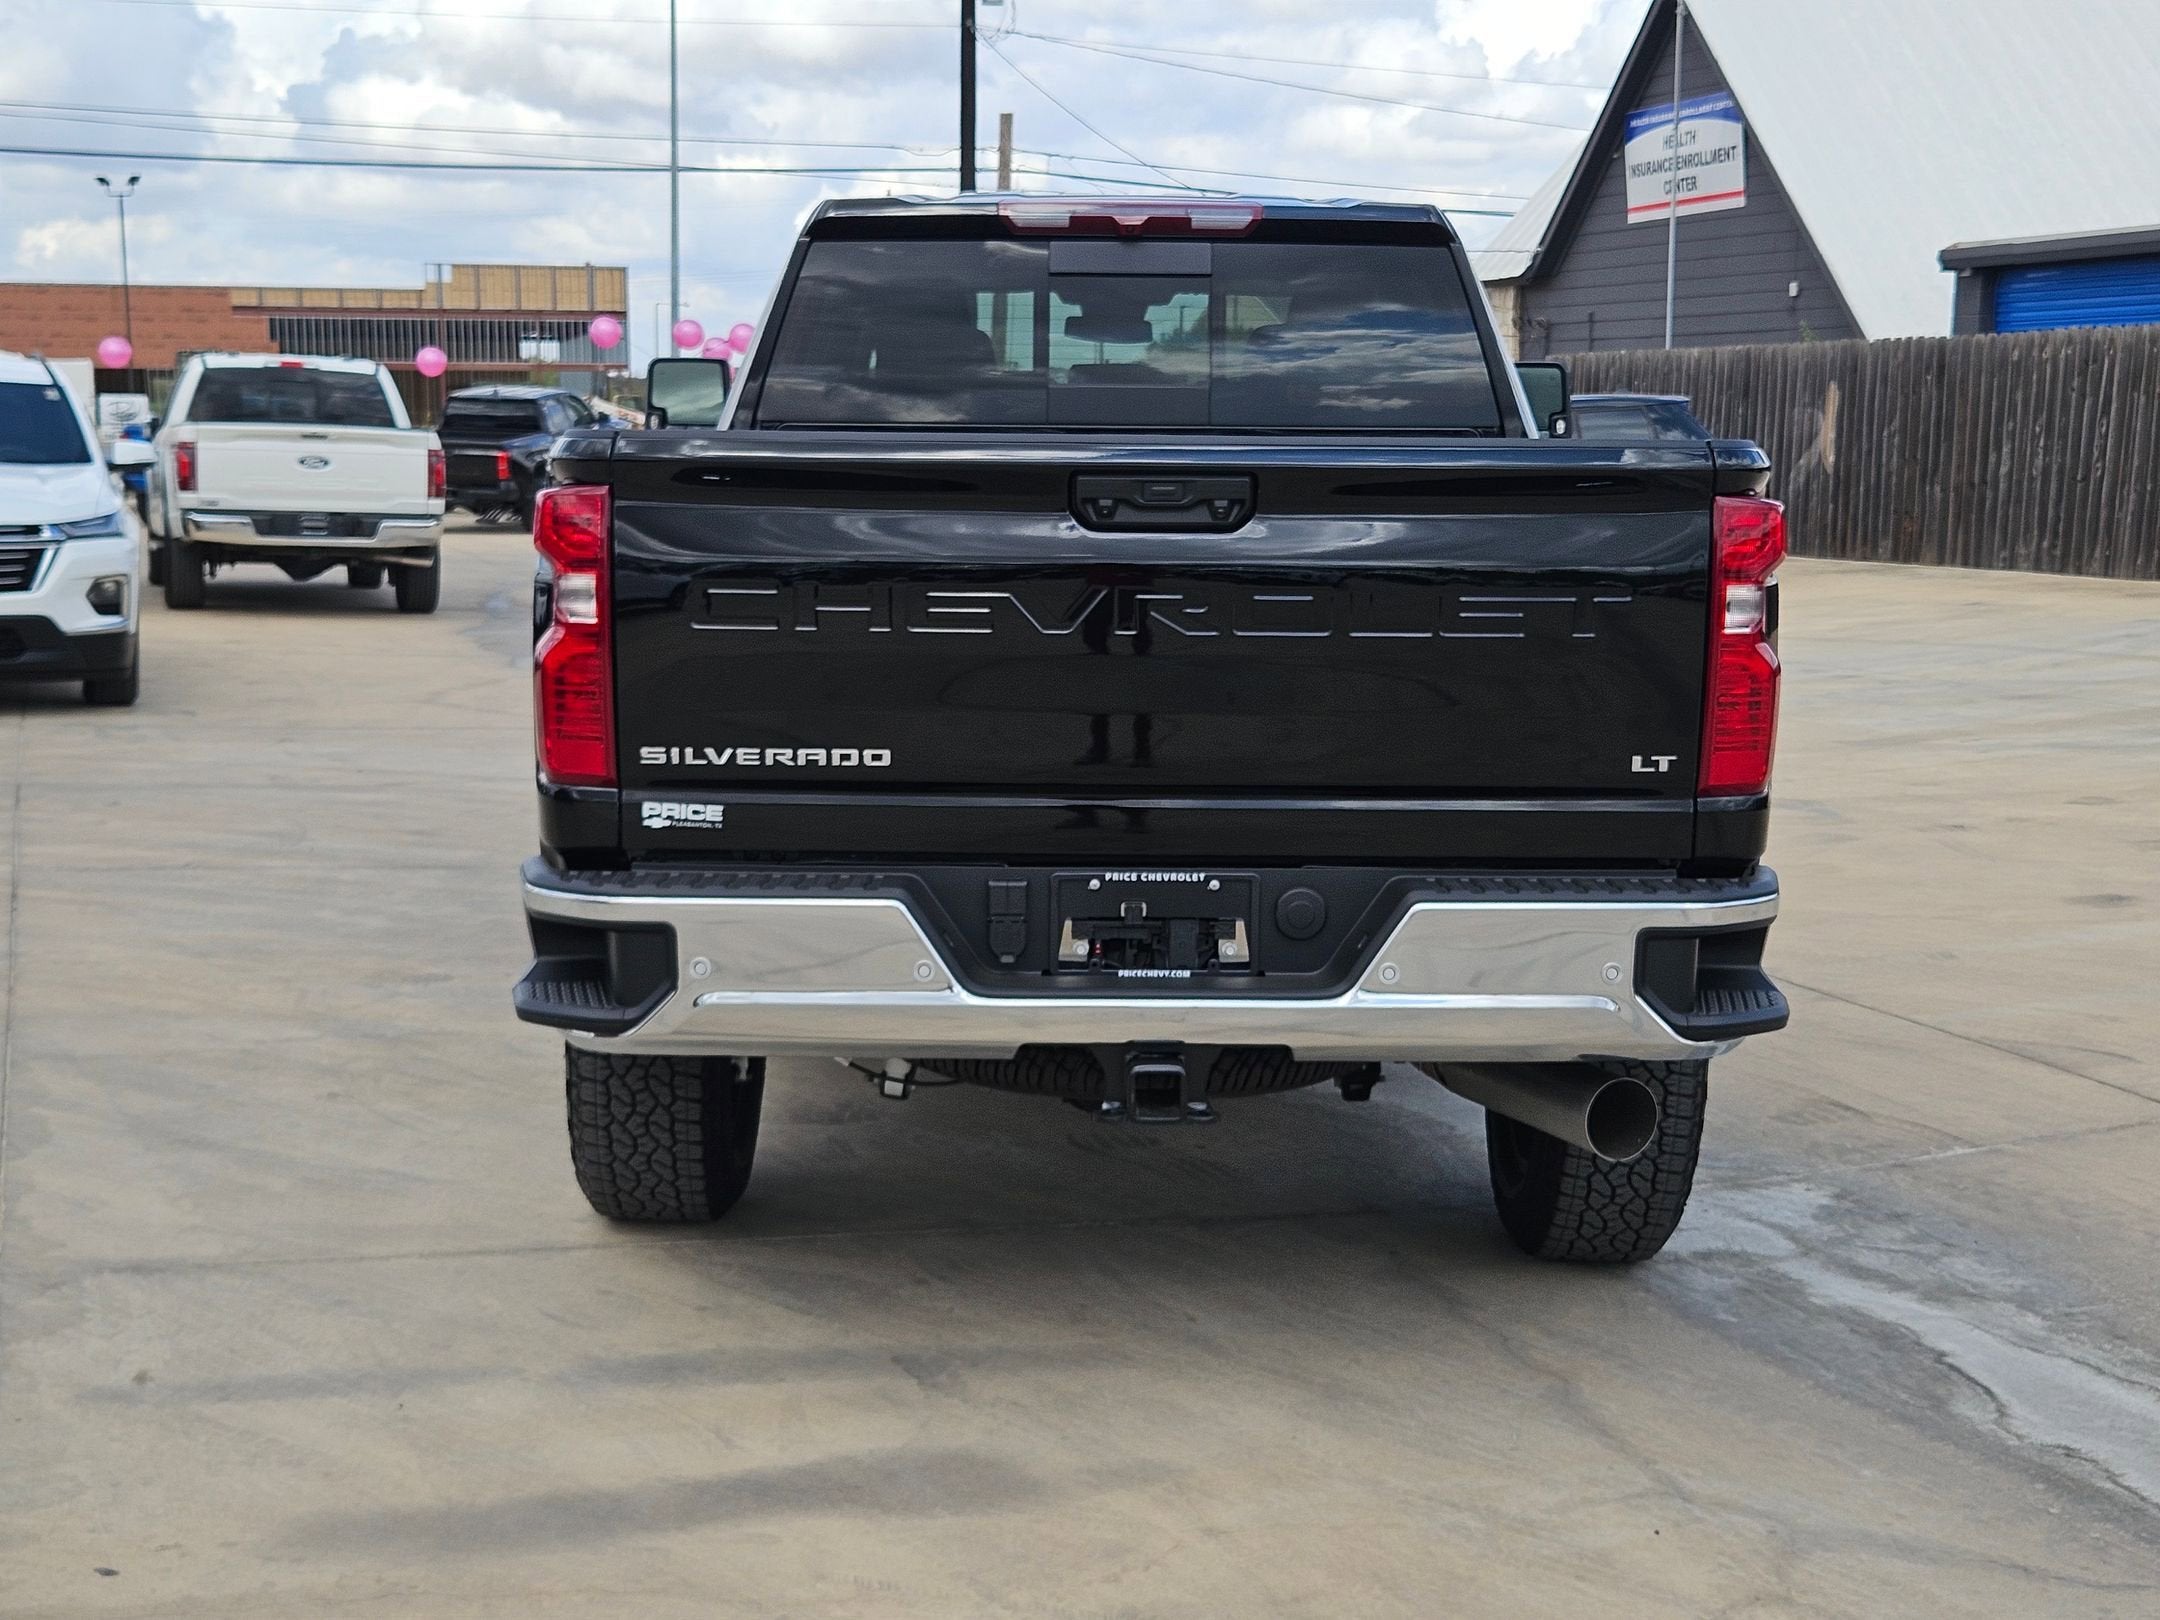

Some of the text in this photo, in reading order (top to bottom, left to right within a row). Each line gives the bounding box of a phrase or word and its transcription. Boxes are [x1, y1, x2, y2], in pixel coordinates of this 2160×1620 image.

[1662, 130, 1697, 150] HELTH
[1628, 146, 1737, 178] INSURANCE ENROLLMENT
[689, 578, 1634, 637] CHEVROLET
[639, 746, 892, 767] SILVERADO
[1631, 755, 1678, 773] LT
[641, 801, 724, 822] PRICE
[1104, 872, 1206, 882] PRICE CHEVROLET
